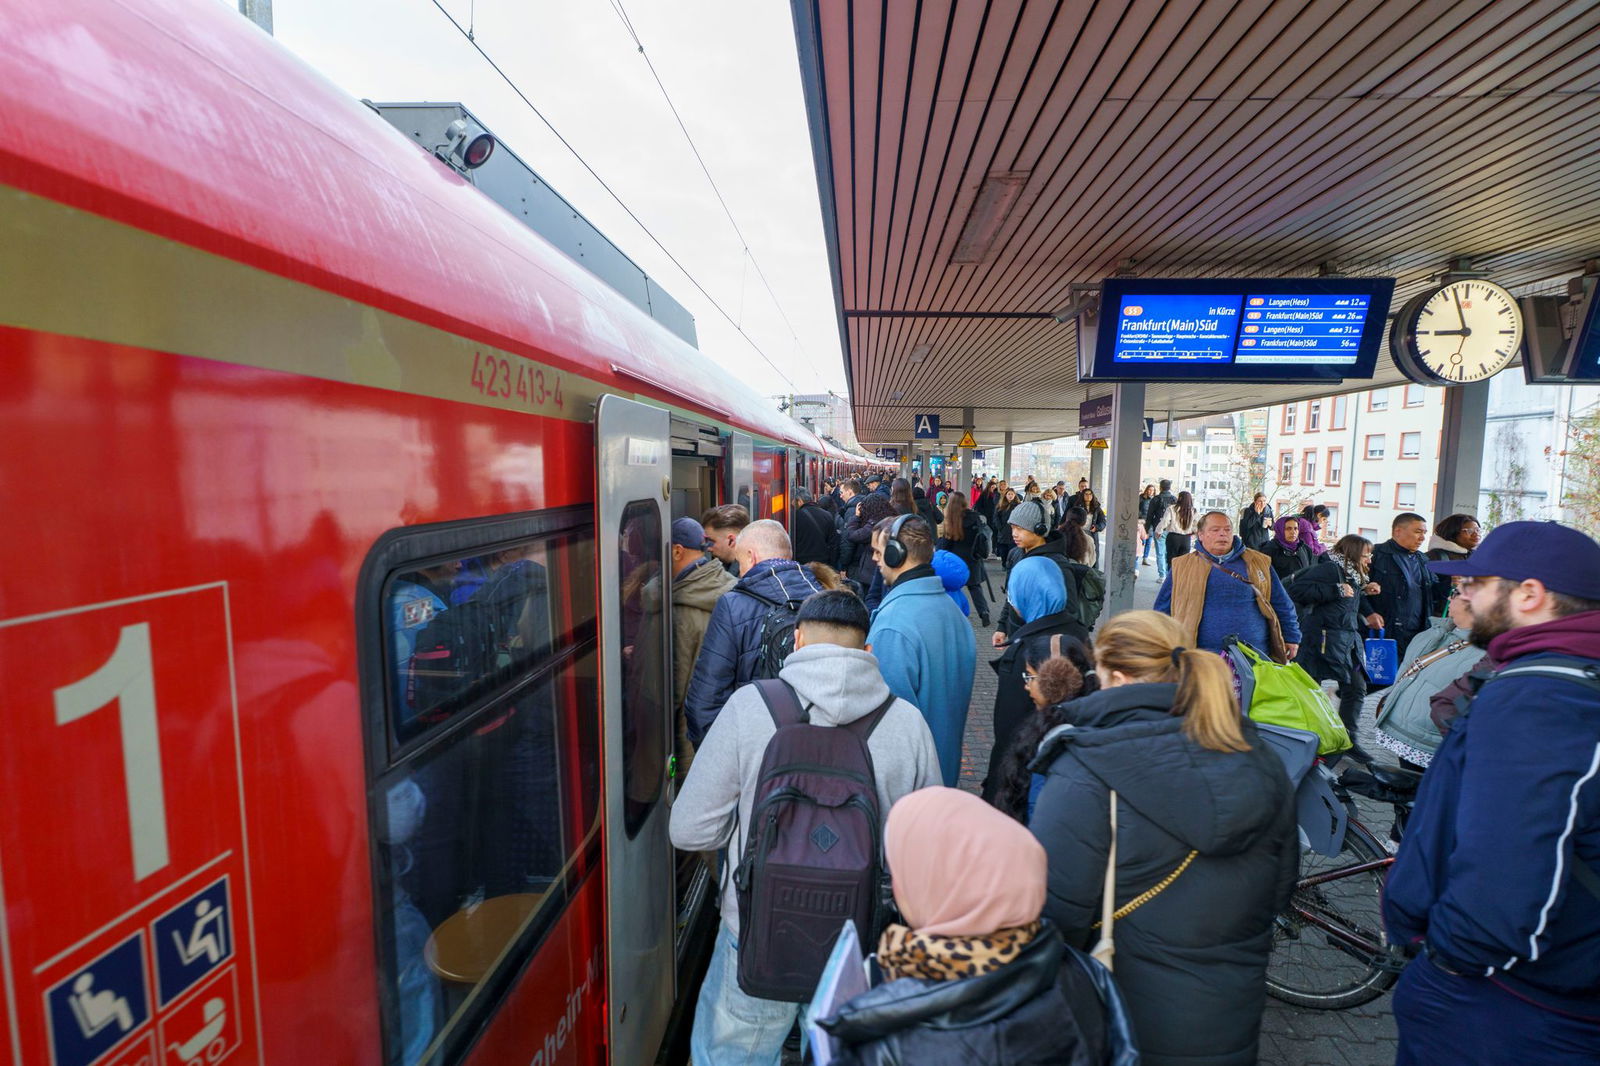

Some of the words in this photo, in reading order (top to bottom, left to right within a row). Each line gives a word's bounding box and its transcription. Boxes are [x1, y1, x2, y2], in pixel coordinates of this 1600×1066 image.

[1268, 298, 1309, 307] Langen(Hess)
[1209, 307, 1216, 315] in
[1217, 306, 1236, 315] Kürze
[1265, 312, 1324, 320] Frankfurt(Main)Süd
[1121, 319, 1218, 332] Frankfurt(Main)Süd
[1263, 326, 1304, 334] Langen(Hess)
[1343, 326, 1353, 334] 31
[1260, 339, 1318, 348] Frankfurt(Main)Süd
[1340, 339, 1350, 347] 56
[471, 352, 511, 399] 423
[516, 365, 564, 409] 413-4
[917, 415, 932, 434] A
[53, 621, 170, 883] 1
[530, 944, 605, 1066] hein-M
